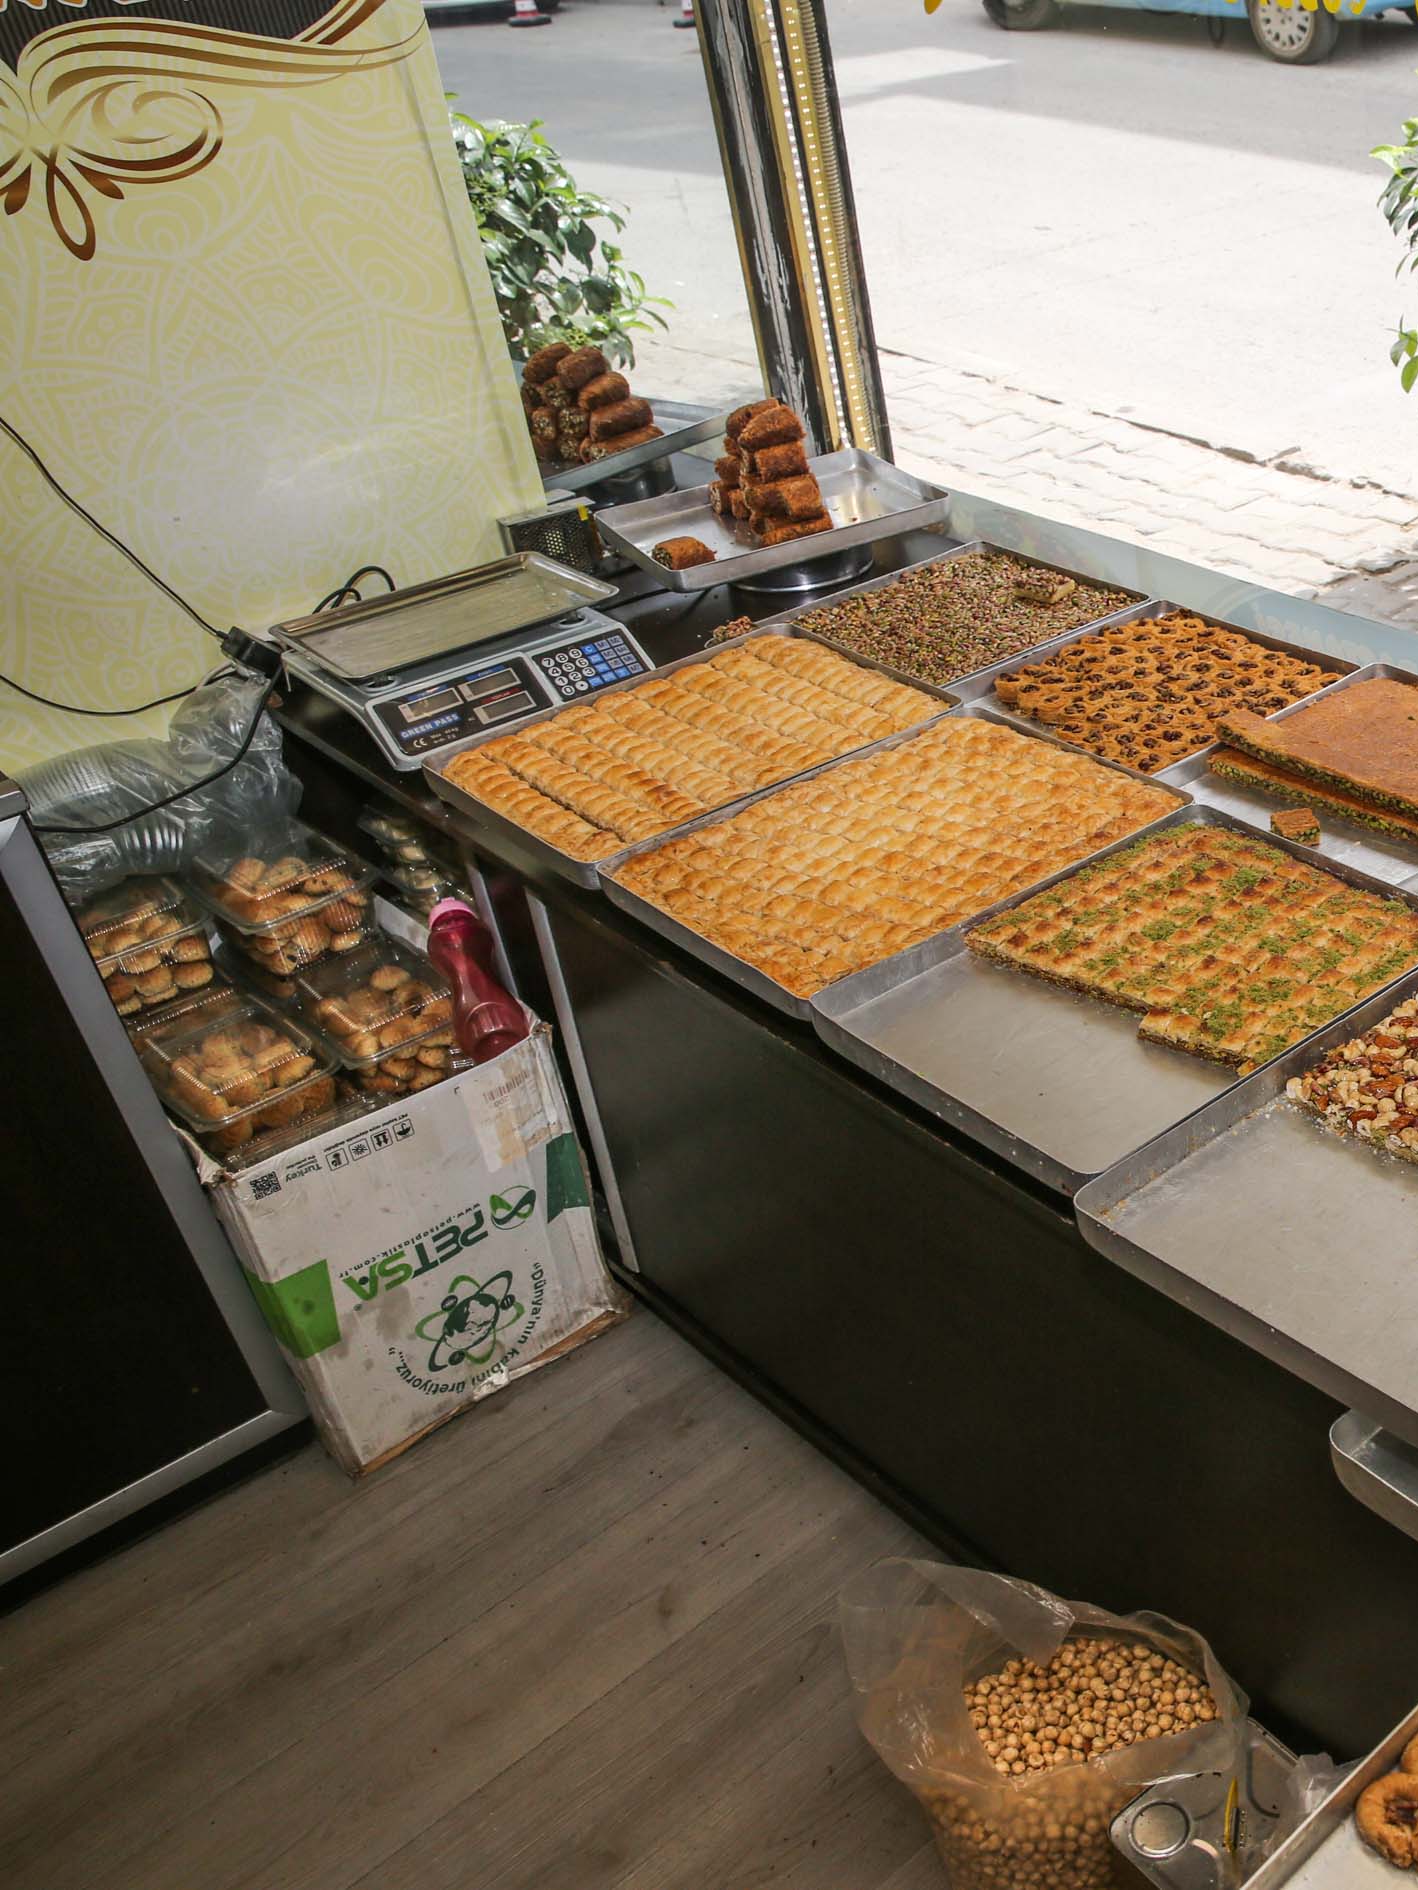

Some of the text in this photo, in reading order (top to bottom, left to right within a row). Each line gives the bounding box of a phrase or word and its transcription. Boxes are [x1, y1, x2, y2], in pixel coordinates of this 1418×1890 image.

[401, 723, 433, 738] GREEN
[434, 713, 460, 729] PASS
[285, 1162, 322, 1182] Turkey
[342, 1209, 489, 1301] PETSA
